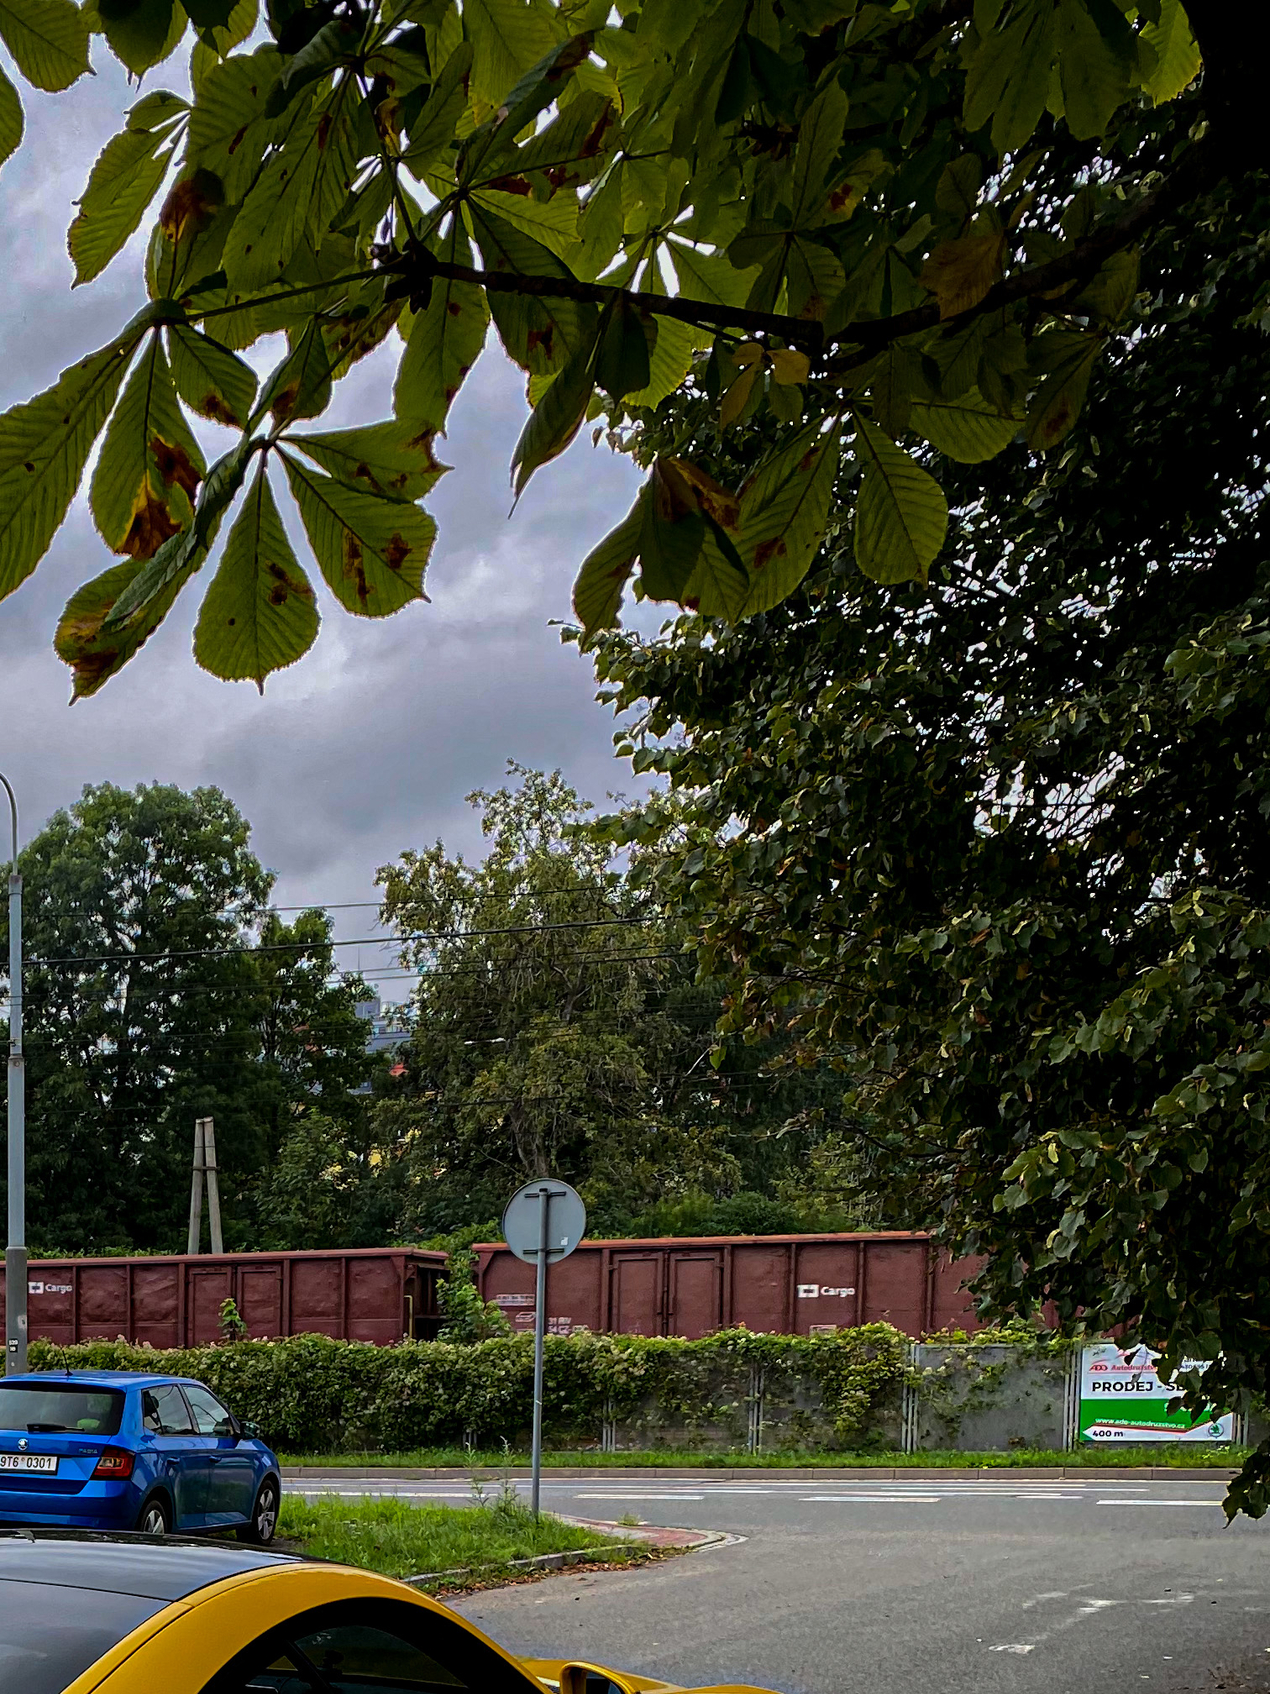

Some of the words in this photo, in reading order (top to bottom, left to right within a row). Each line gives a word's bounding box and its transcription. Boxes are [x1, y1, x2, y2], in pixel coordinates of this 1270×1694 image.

[45, 1284, 73, 1294] Cargo
[820, 1286, 856, 1298] Cargo
[1092, 1381, 1153, 1392] PRODEJ
[1092, 1430, 1112, 1438] 400
[0, 1456, 19, 1467] 9T6
[26, 1457, 52, 1469] 0301
